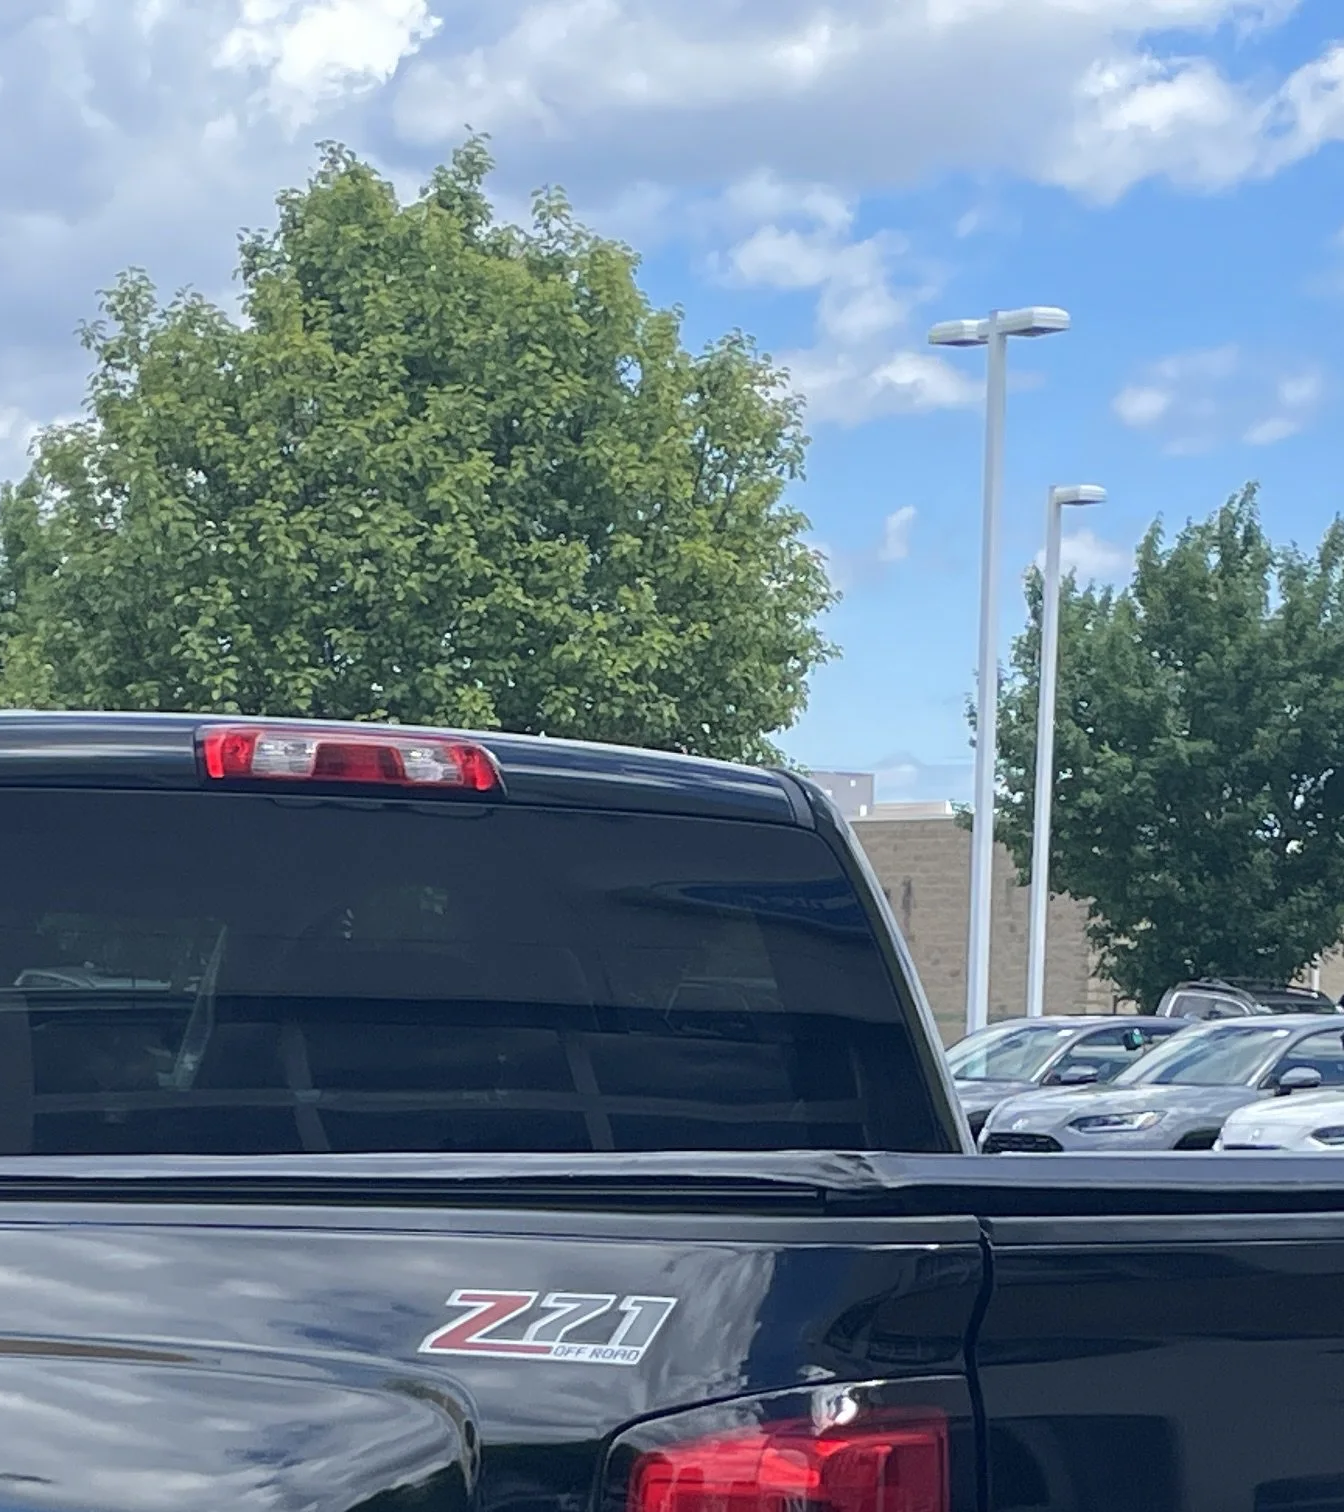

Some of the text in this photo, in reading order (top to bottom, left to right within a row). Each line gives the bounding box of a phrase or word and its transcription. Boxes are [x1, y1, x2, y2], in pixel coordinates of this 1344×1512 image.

[418, 1288, 678, 1356] Z71
[553, 1345, 641, 1362] OFF ROAD
